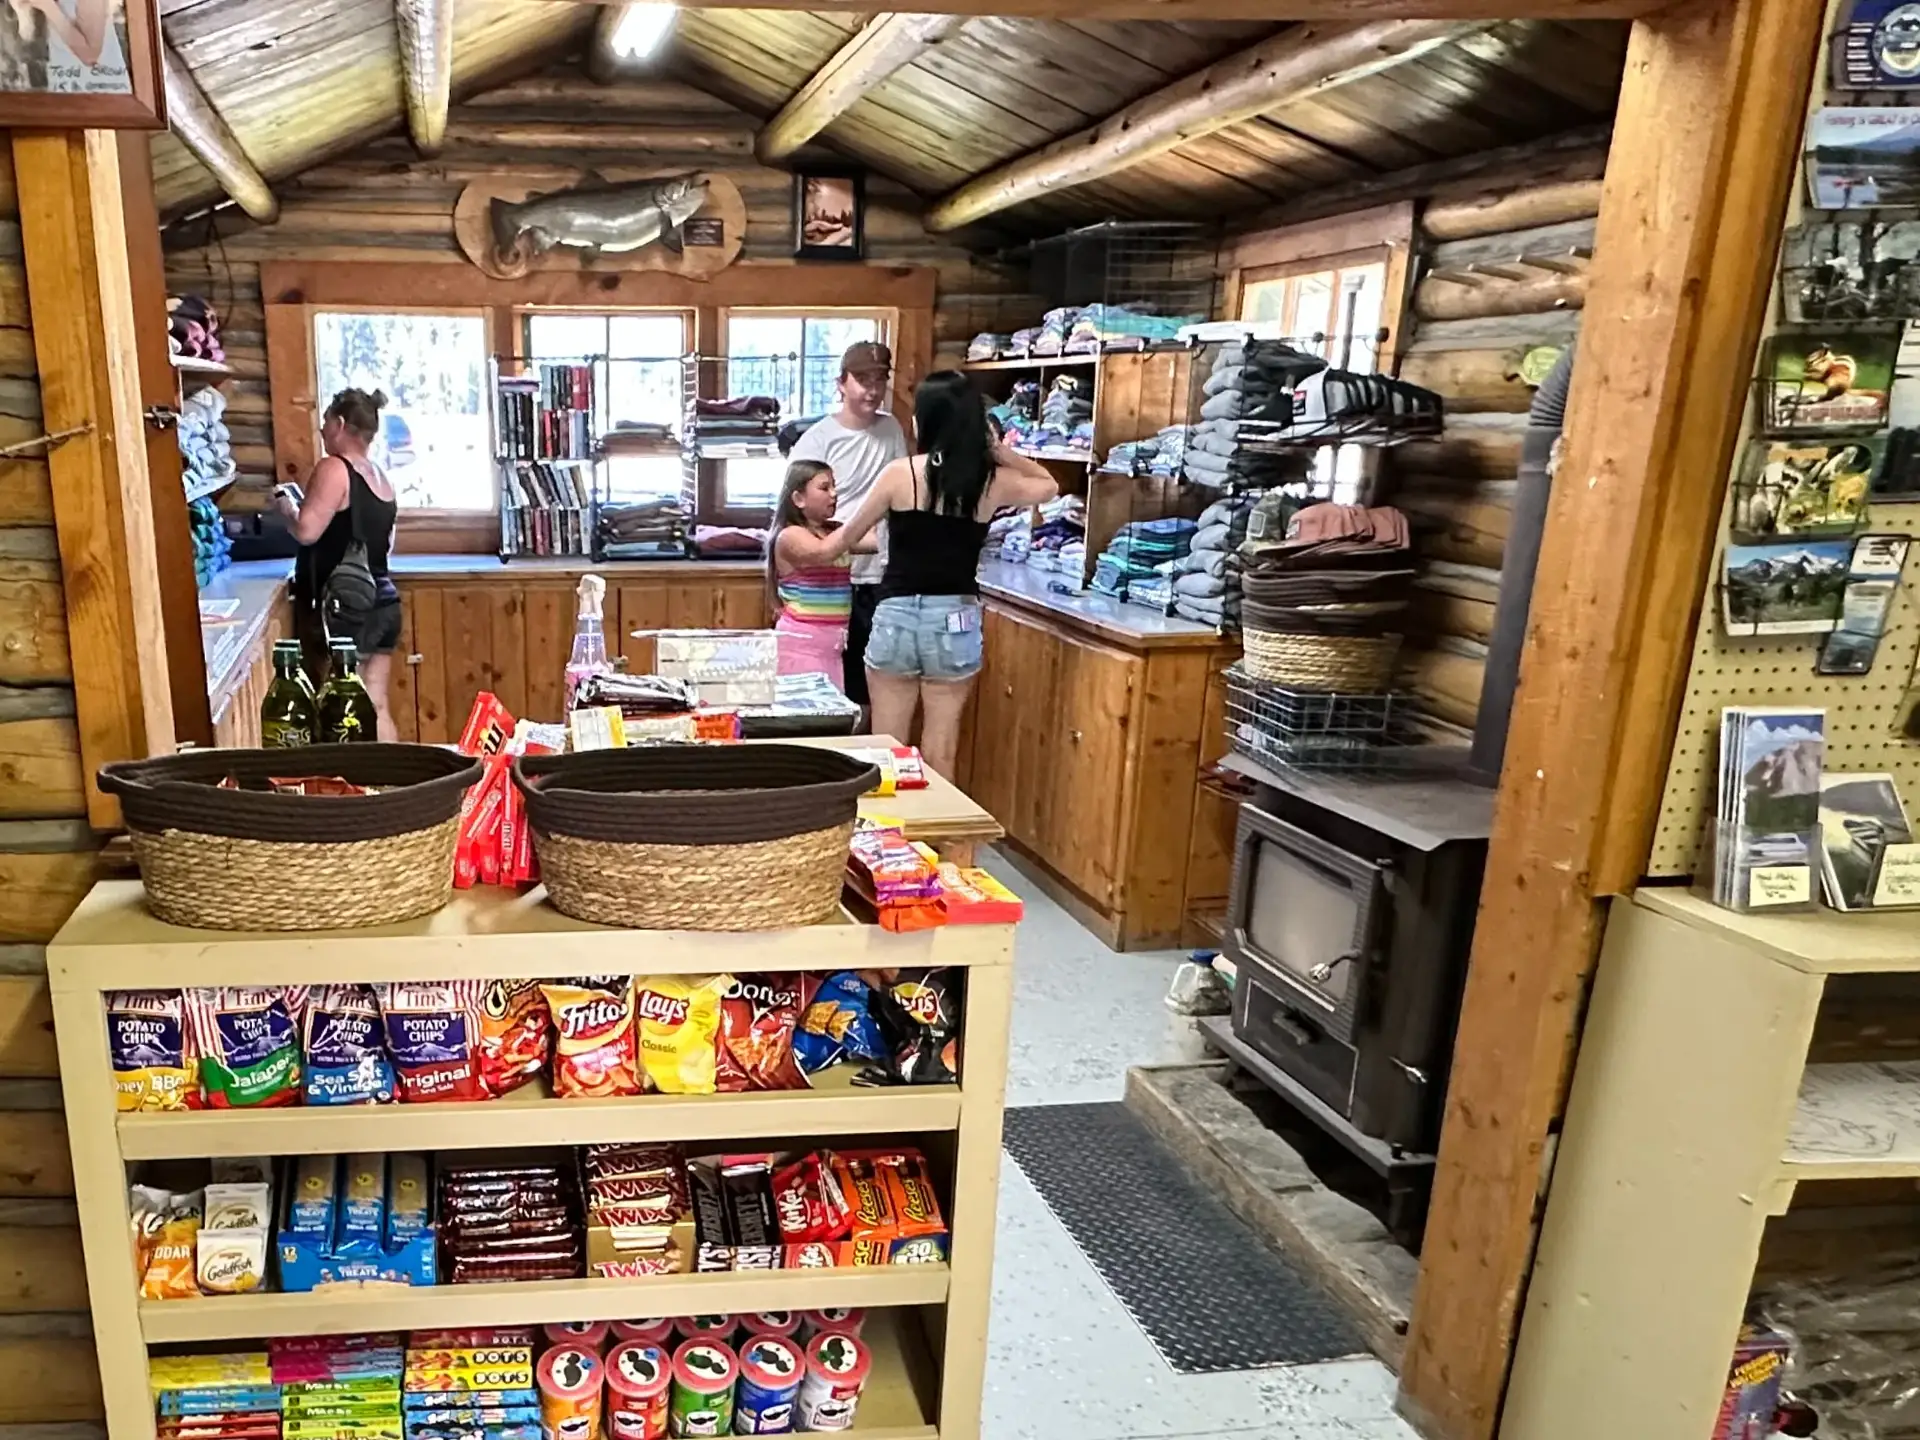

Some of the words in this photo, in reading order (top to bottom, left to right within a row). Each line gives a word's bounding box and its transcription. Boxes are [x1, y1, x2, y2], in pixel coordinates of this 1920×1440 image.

[124, 993, 167, 1011] Tim's
[234, 988, 278, 1007] Tim's
[406, 989, 447, 1008] Tim's
[117, 1020, 166, 1034] POTATO
[234, 1013, 270, 1031] POTA
[329, 1019, 372, 1033] POTATO
[403, 1019, 449, 1032] POTATO
[122, 1032, 160, 1045] CHIPS
[334, 1030, 365, 1044] CHIPS
[409, 1031, 445, 1042] CHIPS
[641, 1039, 677, 1054] Classic
[314, 1074, 345, 1086] Sea
[348, 1067, 384, 1082] Slt
[115, 1080, 145, 1095] oney
[308, 1084, 321, 1096] &
[735, 1192, 766, 1245] ERSHEY'S
[906, 1241, 931, 1257] 30
[207, 1258, 254, 1281] Goldfish
[340, 1268, 378, 1278] TREATS
[473, 1350, 528, 1365] DOTS
[474, 1371, 529, 1385] DOTS
